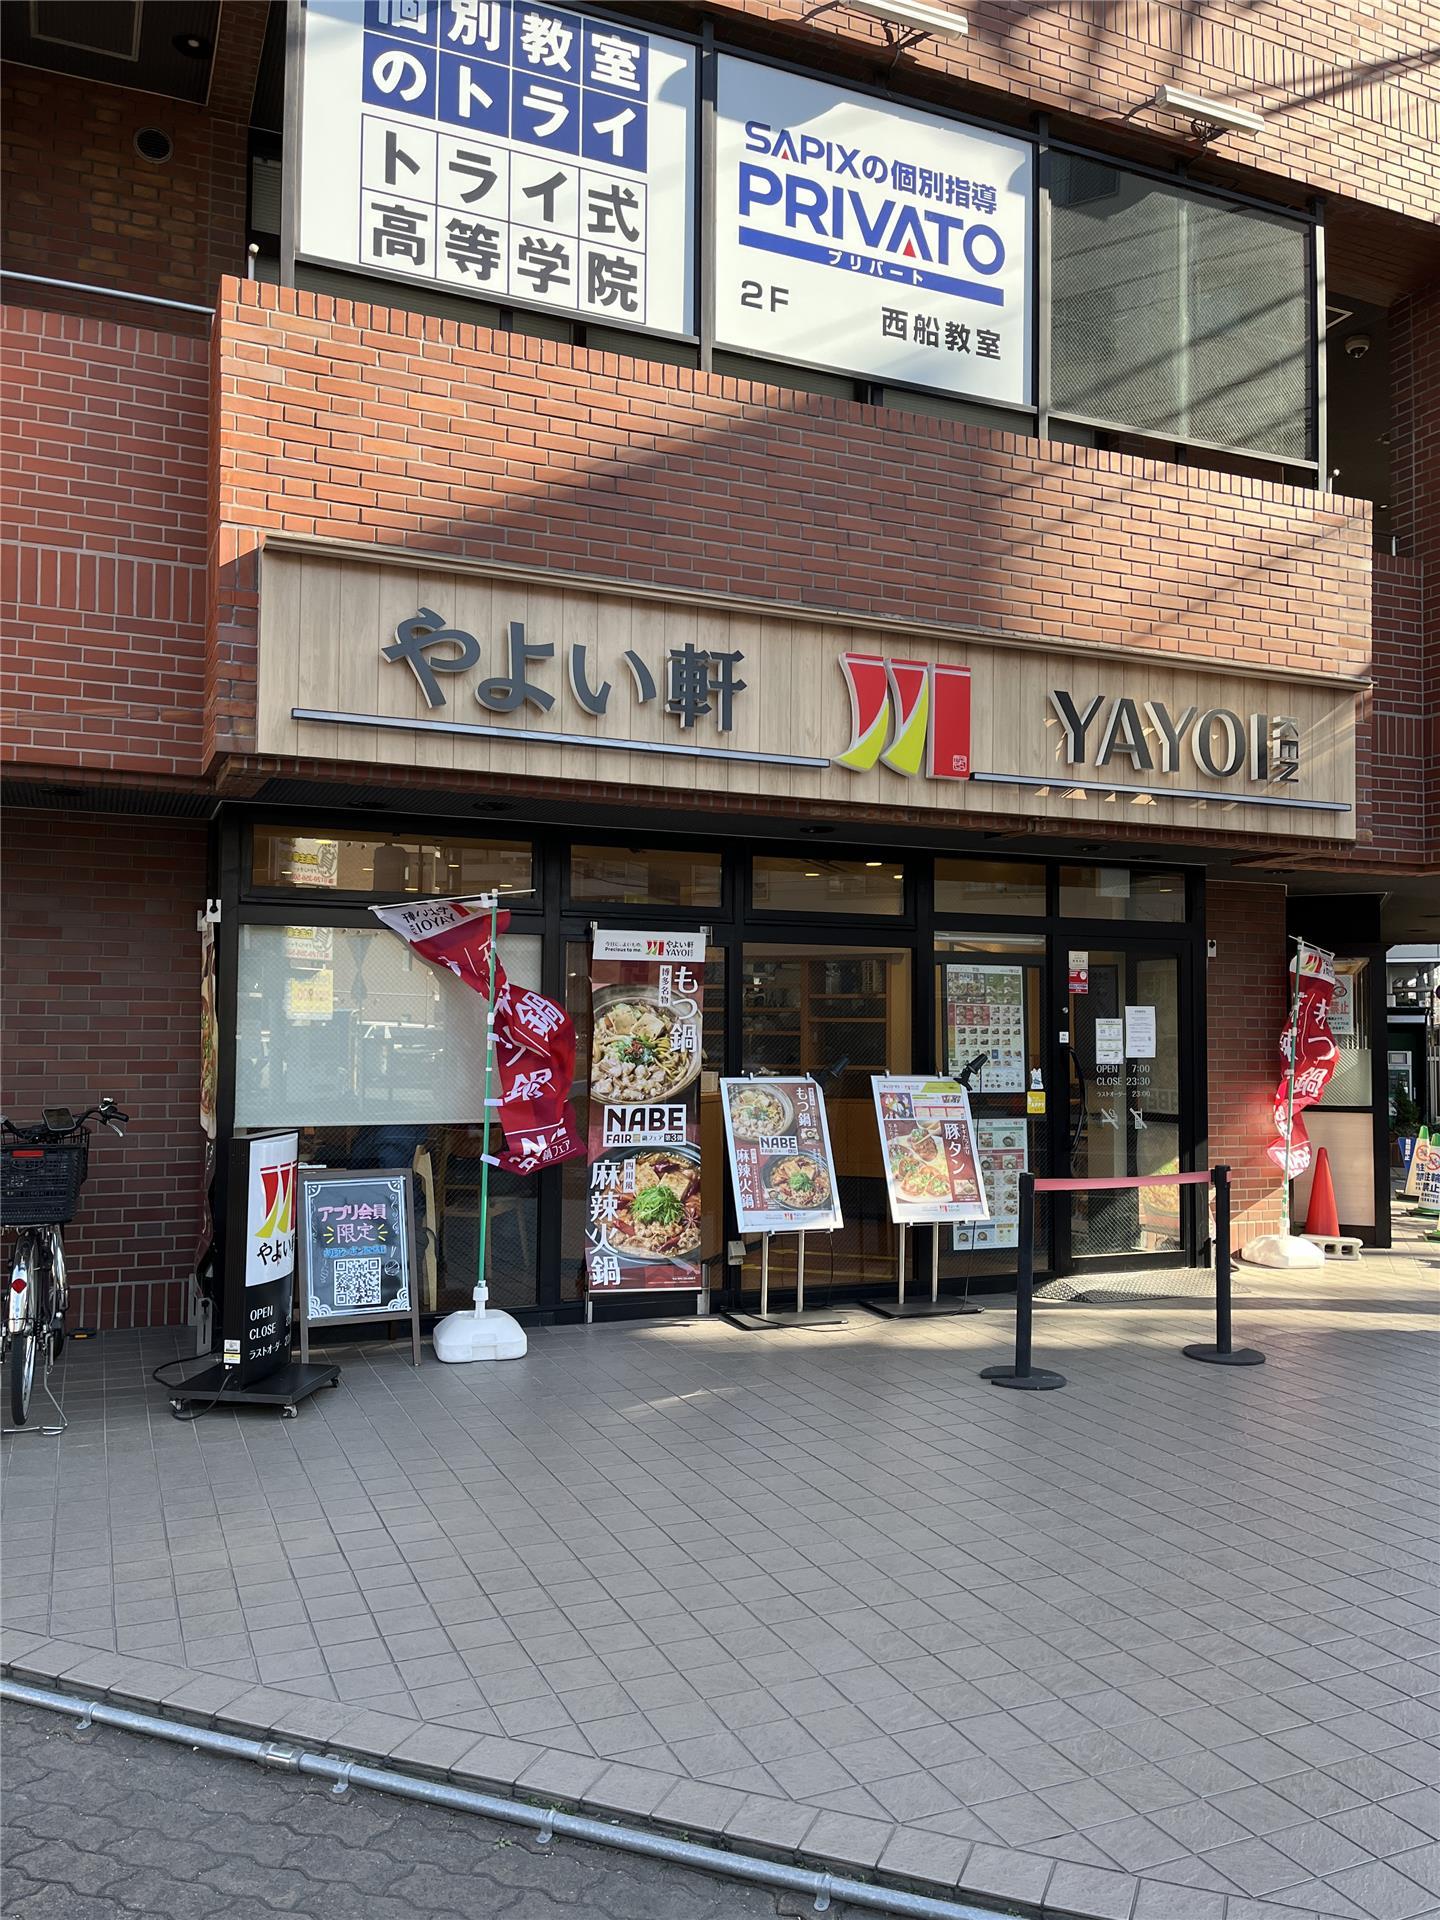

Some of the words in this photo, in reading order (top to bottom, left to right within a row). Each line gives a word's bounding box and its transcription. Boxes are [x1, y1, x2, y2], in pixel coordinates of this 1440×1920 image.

[376, 0, 640, 92] 個別教室
[372, 50, 636, 157] のトライ
[385, 130, 640, 243] トライ式
[745, 120, 997, 215] SAPIXの個別指導
[739, 160, 1005, 276] PRIVATO
[371, 202, 638, 313] 高等学院
[827, 249, 924, 285] プリバート
[741, 280, 789, 313] 2F
[881, 306, 1001, 361] 西船教室
[381, 606, 747, 733] やよい軒
[1049, 689, 1268, 782] YAYOI
[669, 965, 699, 1053] もつ鍋
[1096, 1064, 1119, 1074] OPEN
[1131, 1064, 1151, 1074] 7:00
[1096, 1076, 1123, 1087] CLOSE
[1126, 1076, 1151, 1087] 23:30
[606, 1107, 684, 1132] NABE
[796, 1087, 812, 1128] もつ鍋
[606, 1134, 632, 1144] FAIR
[760, 1137, 797, 1150] NABE
[943, 1123, 966, 1175] 豚タン
[317, 1203, 388, 1222] アプリ会員
[336, 1223, 376, 1244] 限定
[589, 1159, 621, 1287] 麻辣火鍋
[249, 1305, 274, 1322] OPEN
[249, 1321, 277, 1341] CLOSE
